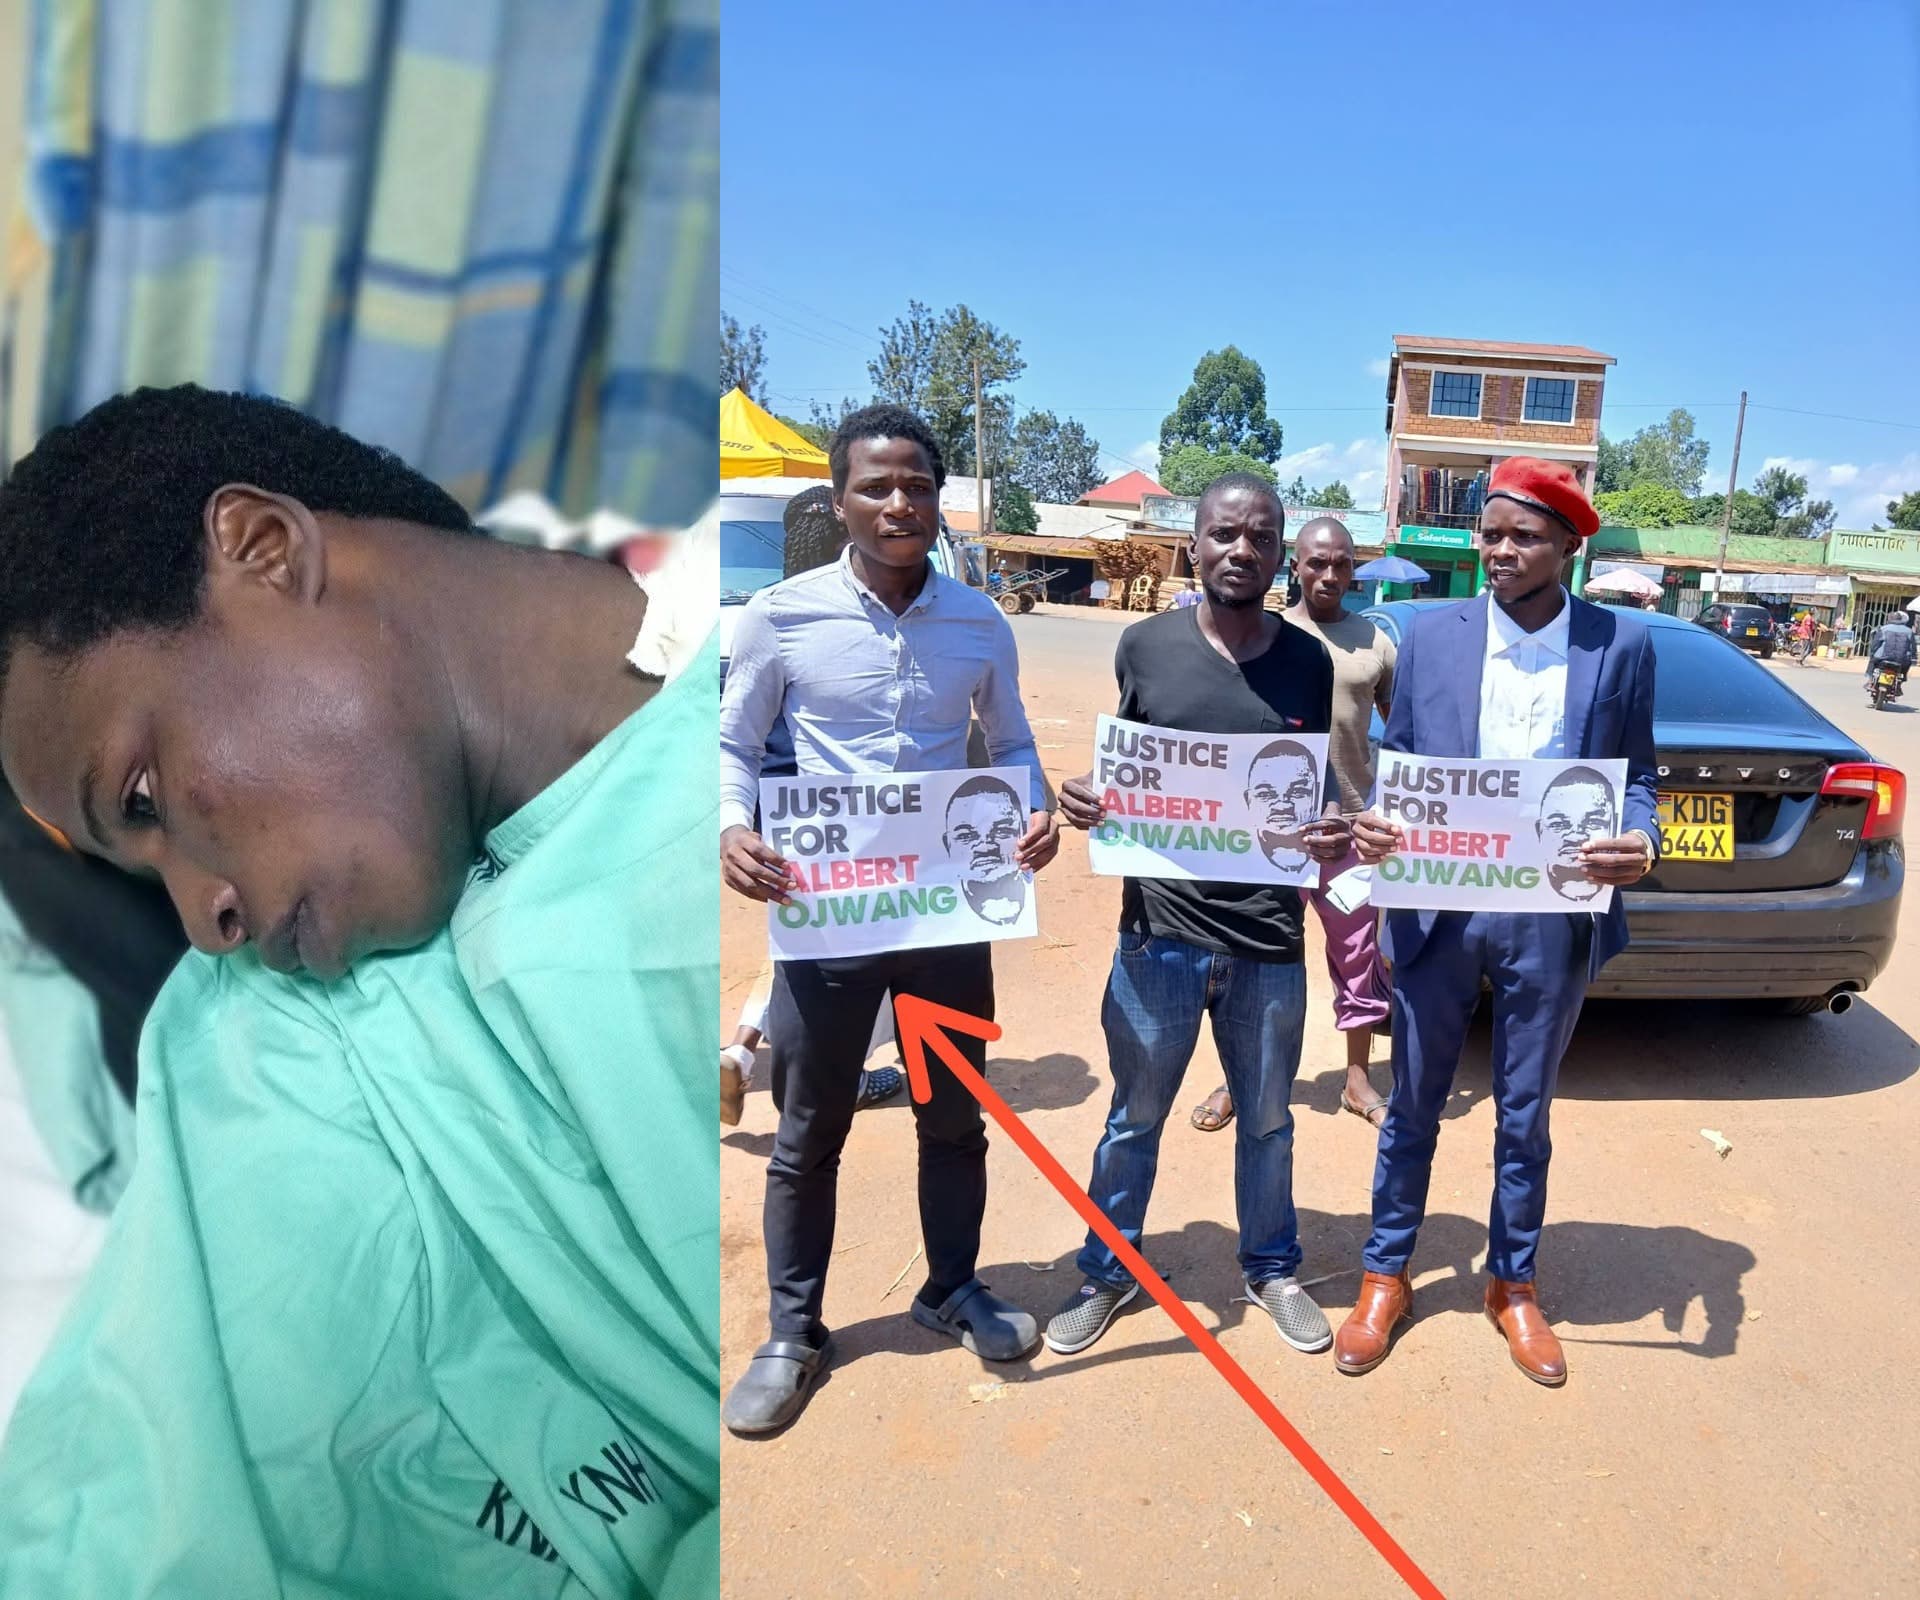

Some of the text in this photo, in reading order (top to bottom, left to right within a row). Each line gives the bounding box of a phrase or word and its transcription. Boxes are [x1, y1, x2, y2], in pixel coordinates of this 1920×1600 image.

[720, 440, 754, 452] ing
[1417, 533, 1464, 545] Safaricom
[1839, 533, 1906, 551] JUNCTION
[1100, 724, 1229, 770] JUSTICE
[1099, 758, 1162, 791] FOR
[1383, 761, 1521, 798] JUSTICE
[1657, 765, 1791, 779] OLVO
[769, 783, 922, 820] JUSTICE
[1102, 788, 1223, 822] ALBERT
[1382, 793, 1448, 826] FOR
[1673, 795, 1726, 824] KDG
[771, 824, 850, 857] FOR
[1098, 820, 1252, 854] OJWANG
[1660, 827, 1727, 858] 644X
[1836, 829, 1855, 841] T4
[777, 854, 920, 894] ALBERT
[1378, 856, 1541, 889] OJWANG
[777, 886, 958, 929] OJWANG
[476, 1478, 560, 1562] KN
